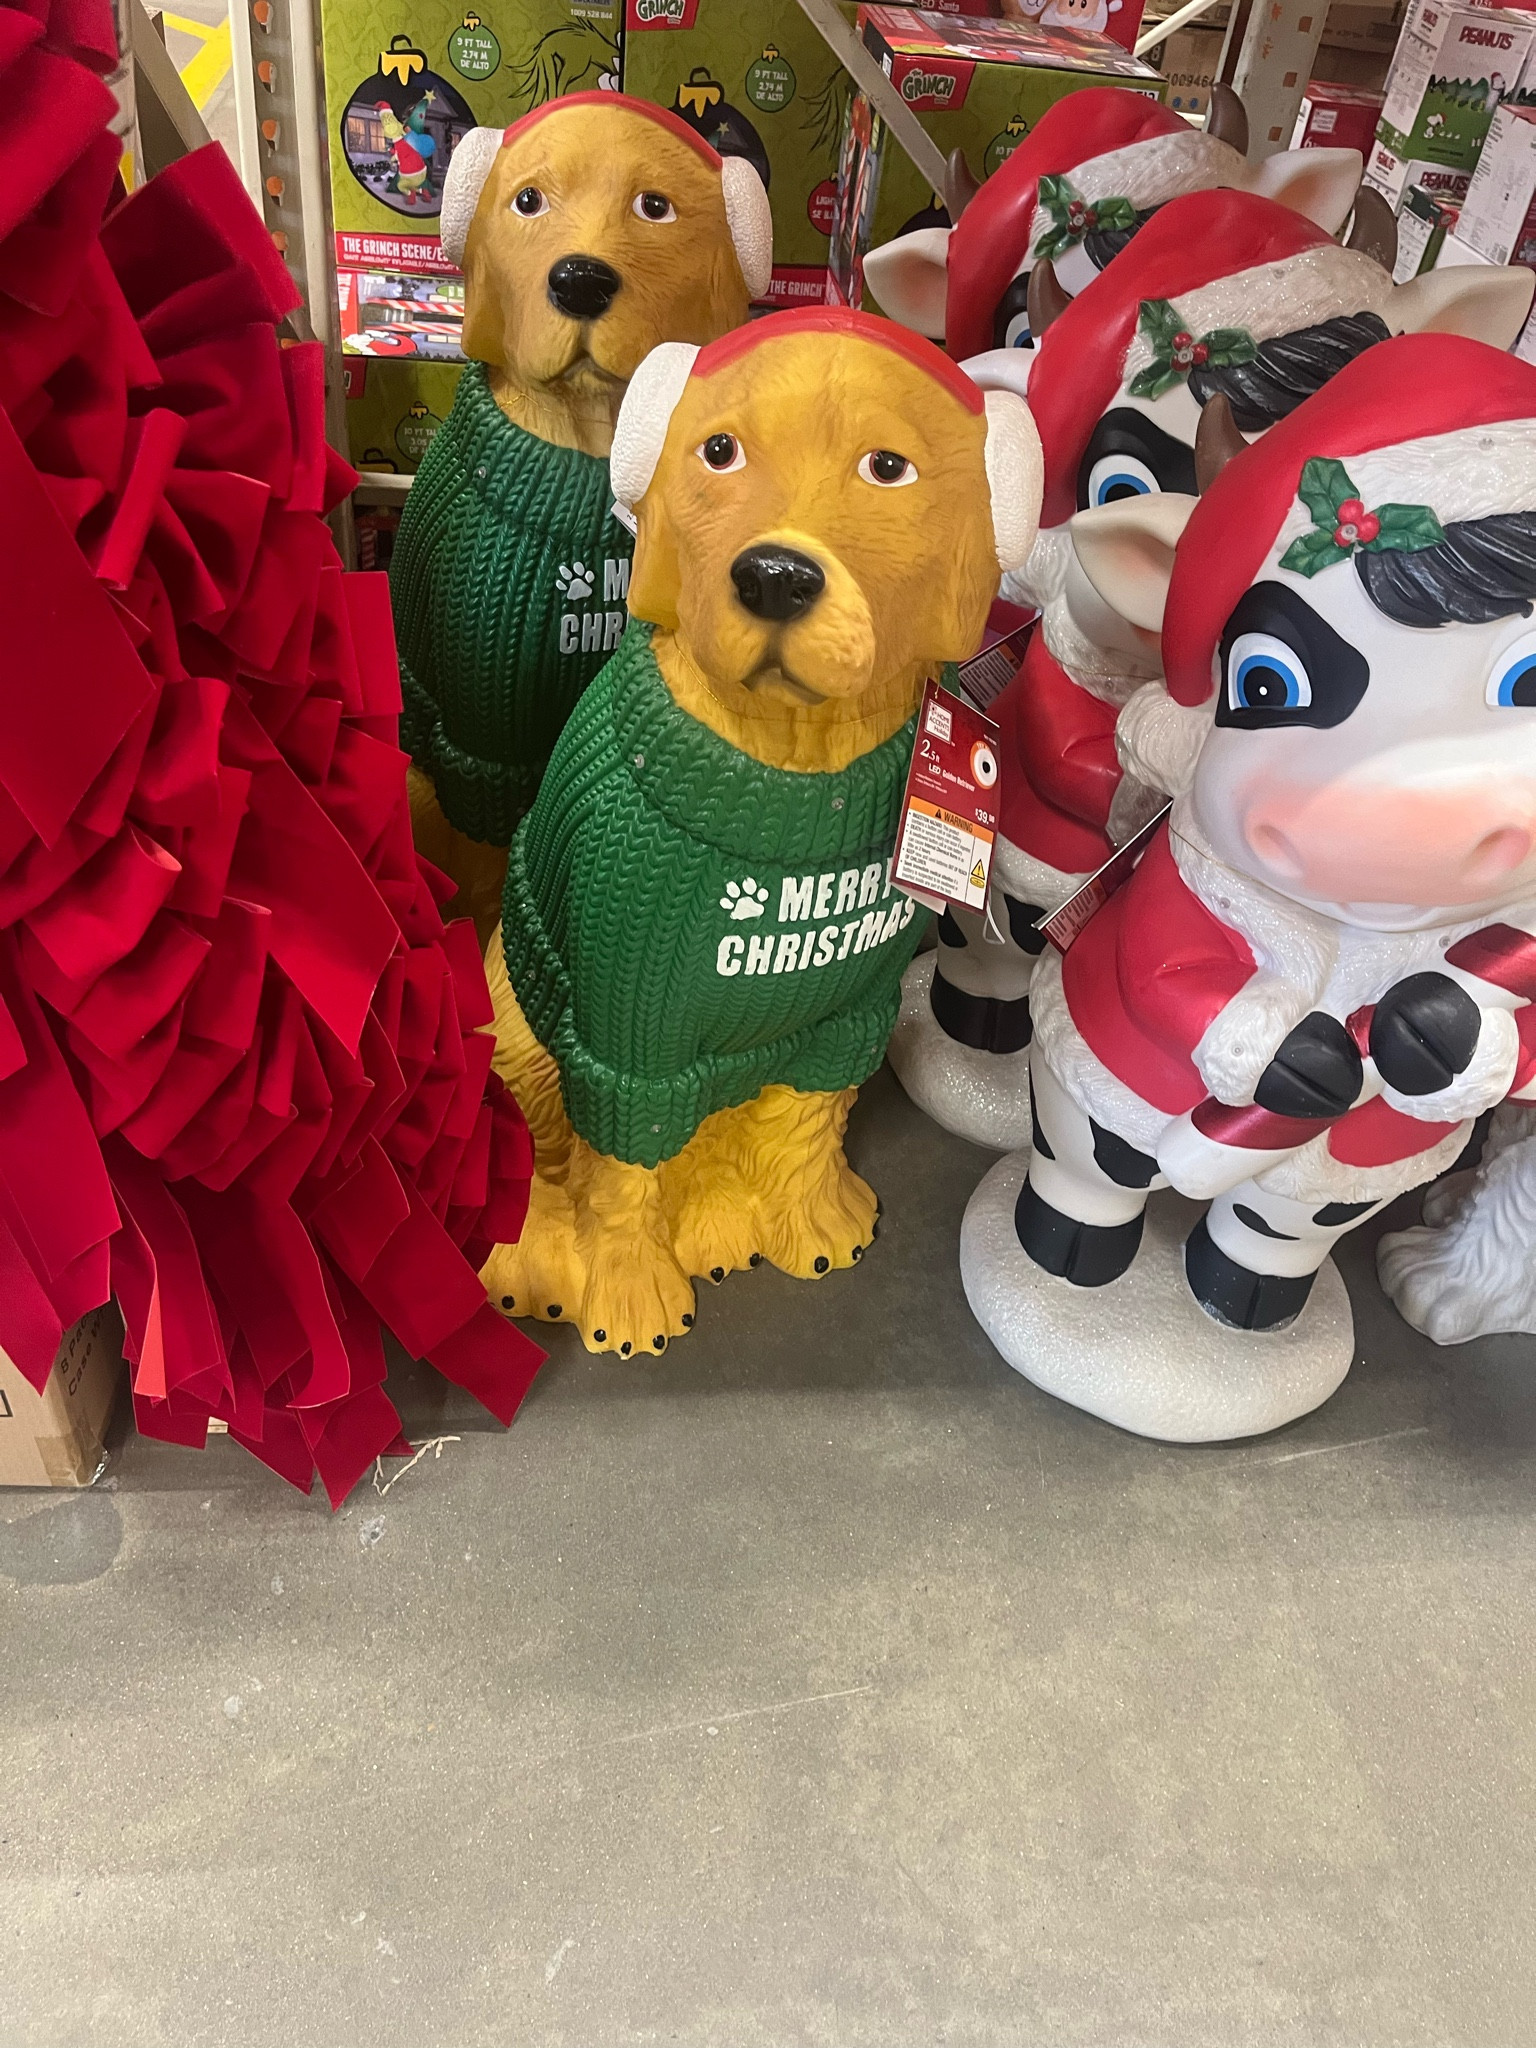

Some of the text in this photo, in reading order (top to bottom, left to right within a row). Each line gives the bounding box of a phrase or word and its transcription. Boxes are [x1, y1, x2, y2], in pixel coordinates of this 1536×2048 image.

[637, 0, 684, 20] GRINCH
[938, 0, 960, 13] Santa
[457, 37, 492, 49] 9 FT TALL
[1458, 25, 1515, 50] PEANUTS
[460, 59, 490, 70] DE ALTO
[481, 51, 488, 60] M
[773, 71, 788, 81] TALL
[901, 74, 956, 101] GRINCH
[342, 236, 361, 254] THE
[362, 239, 400, 258] GRINCH
[770, 280, 786, 295] THE
[787, 281, 822, 298] GRINCH
[920, 739, 936, 761] 2.5
[928, 763, 941, 775] LED
[944, 811, 973, 833] WARNING
[716, 895, 916, 977] CHRISTMAS
[68, 1342, 92, 1397] Case
